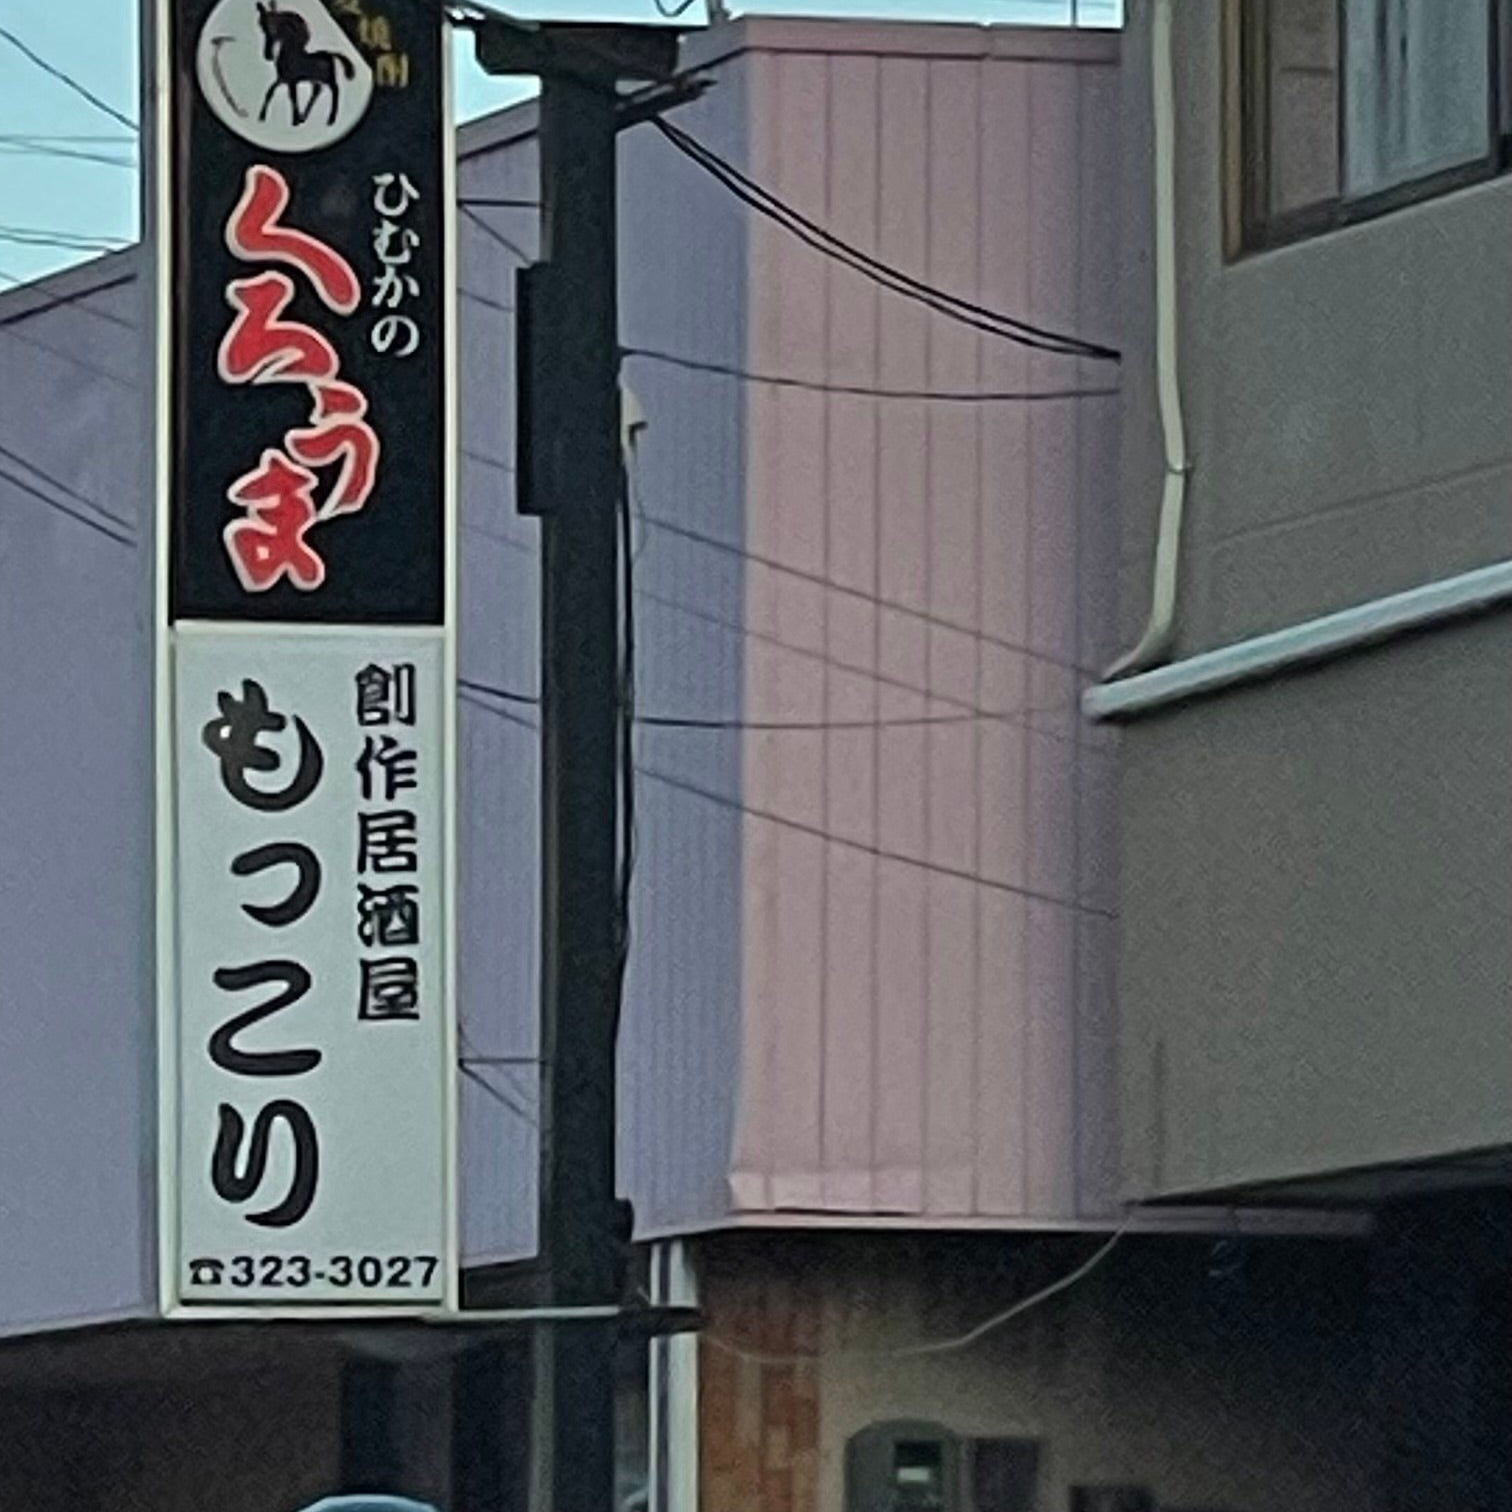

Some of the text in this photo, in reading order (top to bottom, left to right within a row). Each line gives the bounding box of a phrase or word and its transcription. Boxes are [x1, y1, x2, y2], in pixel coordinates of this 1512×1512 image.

[218, 164, 379, 593] くろうま
[372, 172, 420, 356] ひむかの
[201, 678, 324, 1229] もっこり
[354, 662, 421, 1022] 創作居酒屋
[230, 1255, 439, 1289] 323-3027
